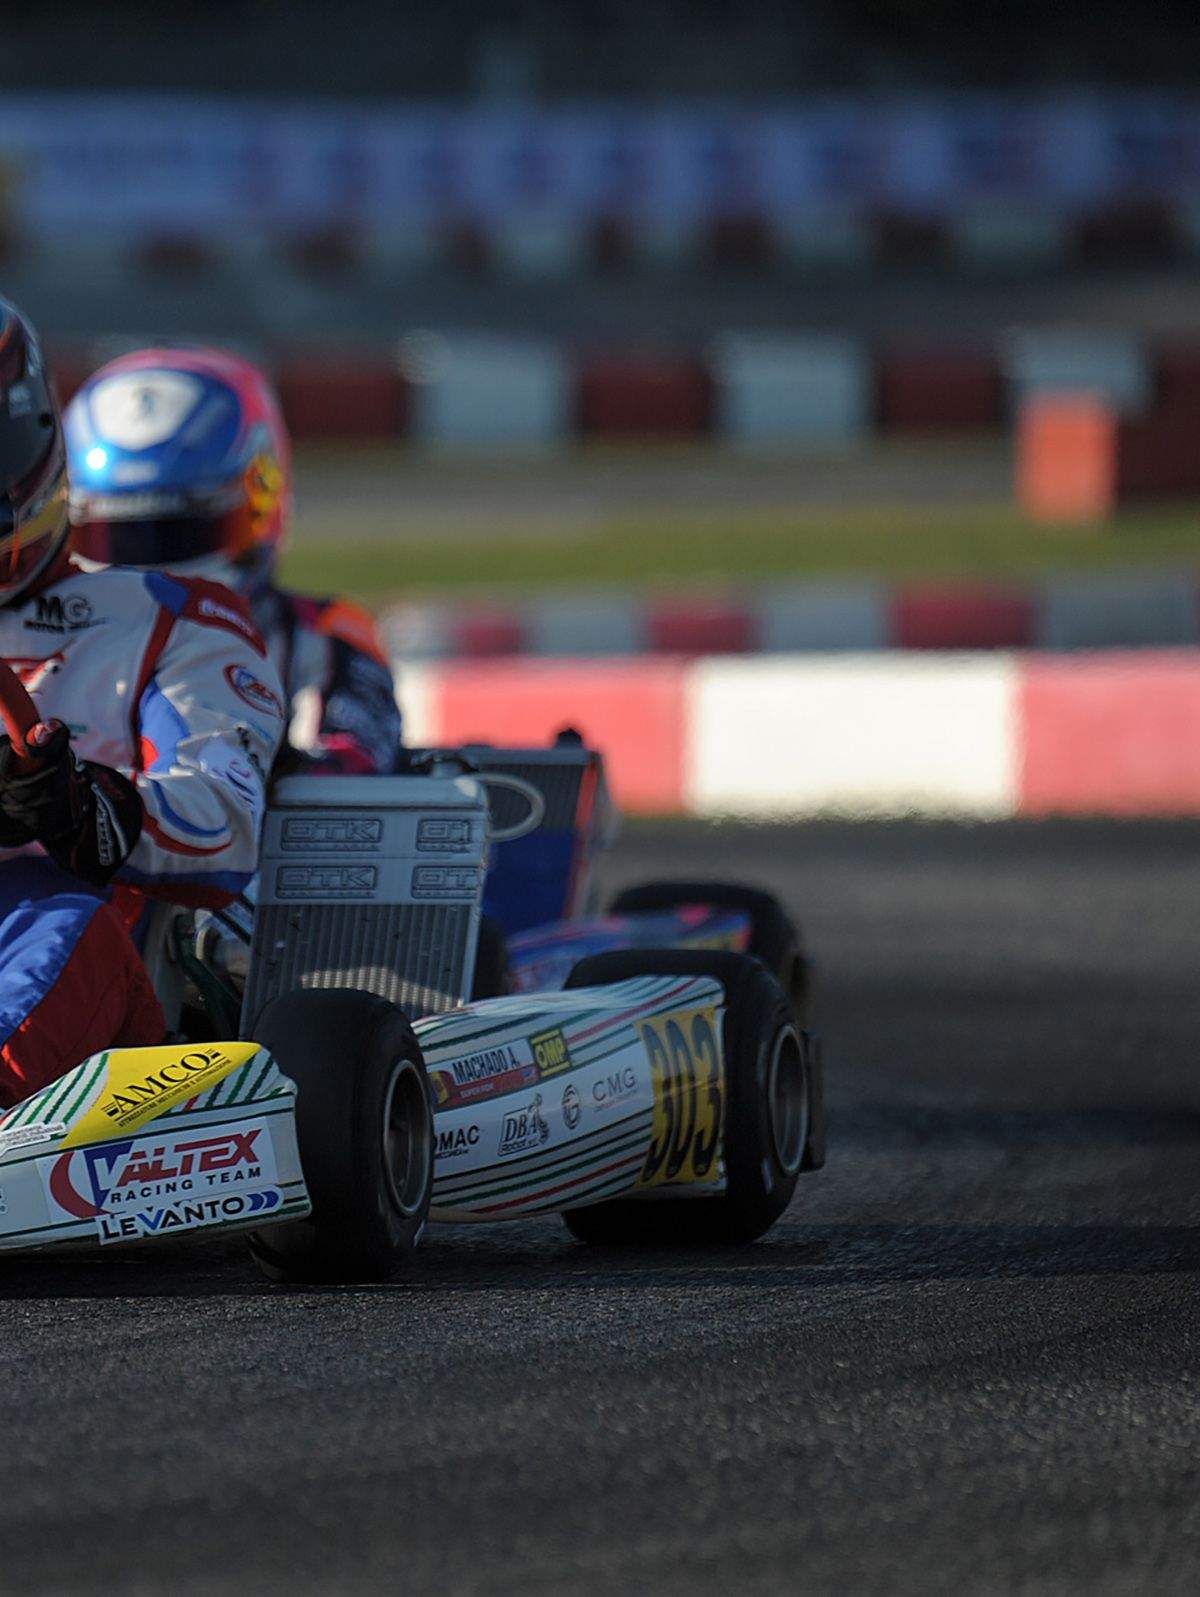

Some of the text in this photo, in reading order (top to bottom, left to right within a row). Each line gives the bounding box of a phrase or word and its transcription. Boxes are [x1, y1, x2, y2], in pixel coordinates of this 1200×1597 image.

[452, 1050, 508, 1083] MACHADO
[534, 1036, 566, 1070] OMP
[111, 1053, 211, 1114] AMCO
[592, 1067, 636, 1102] CMG
[640, 1014, 721, 1183] 303
[504, 1112, 539, 1143] DBA
[83, 1128, 263, 1208] VALTEX
[110, 1166, 262, 1204] RACING TEAM
[101, 1194, 245, 1240] LEVANTO
